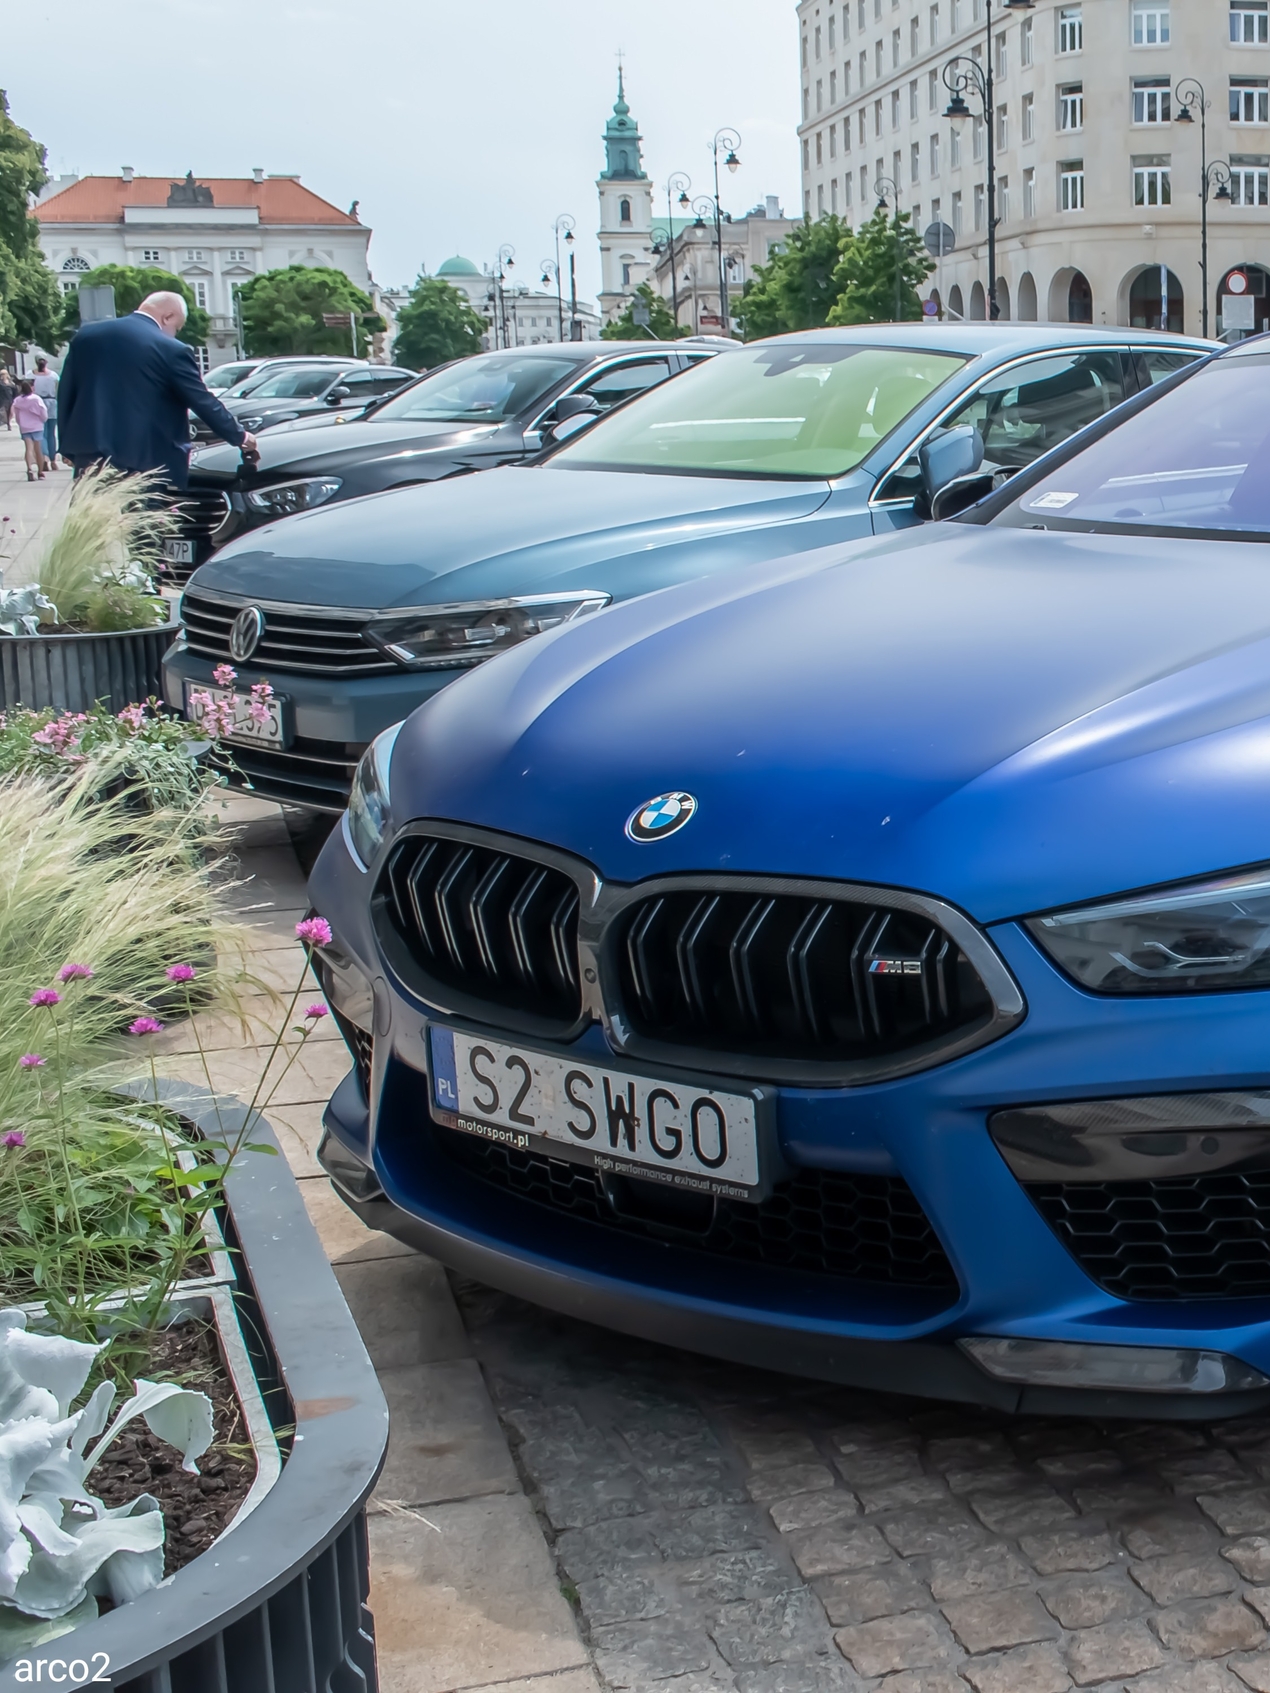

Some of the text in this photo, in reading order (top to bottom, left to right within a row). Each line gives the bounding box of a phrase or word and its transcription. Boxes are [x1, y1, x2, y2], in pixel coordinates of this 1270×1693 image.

[165, 543, 189, 560] 47P
[650, 793, 693, 809] BMW
[438, 1078, 455, 1099] PL
[469, 1045, 728, 1169] S2 SWGO
[595, 1155, 748, 1198] High performance exhaust systems
